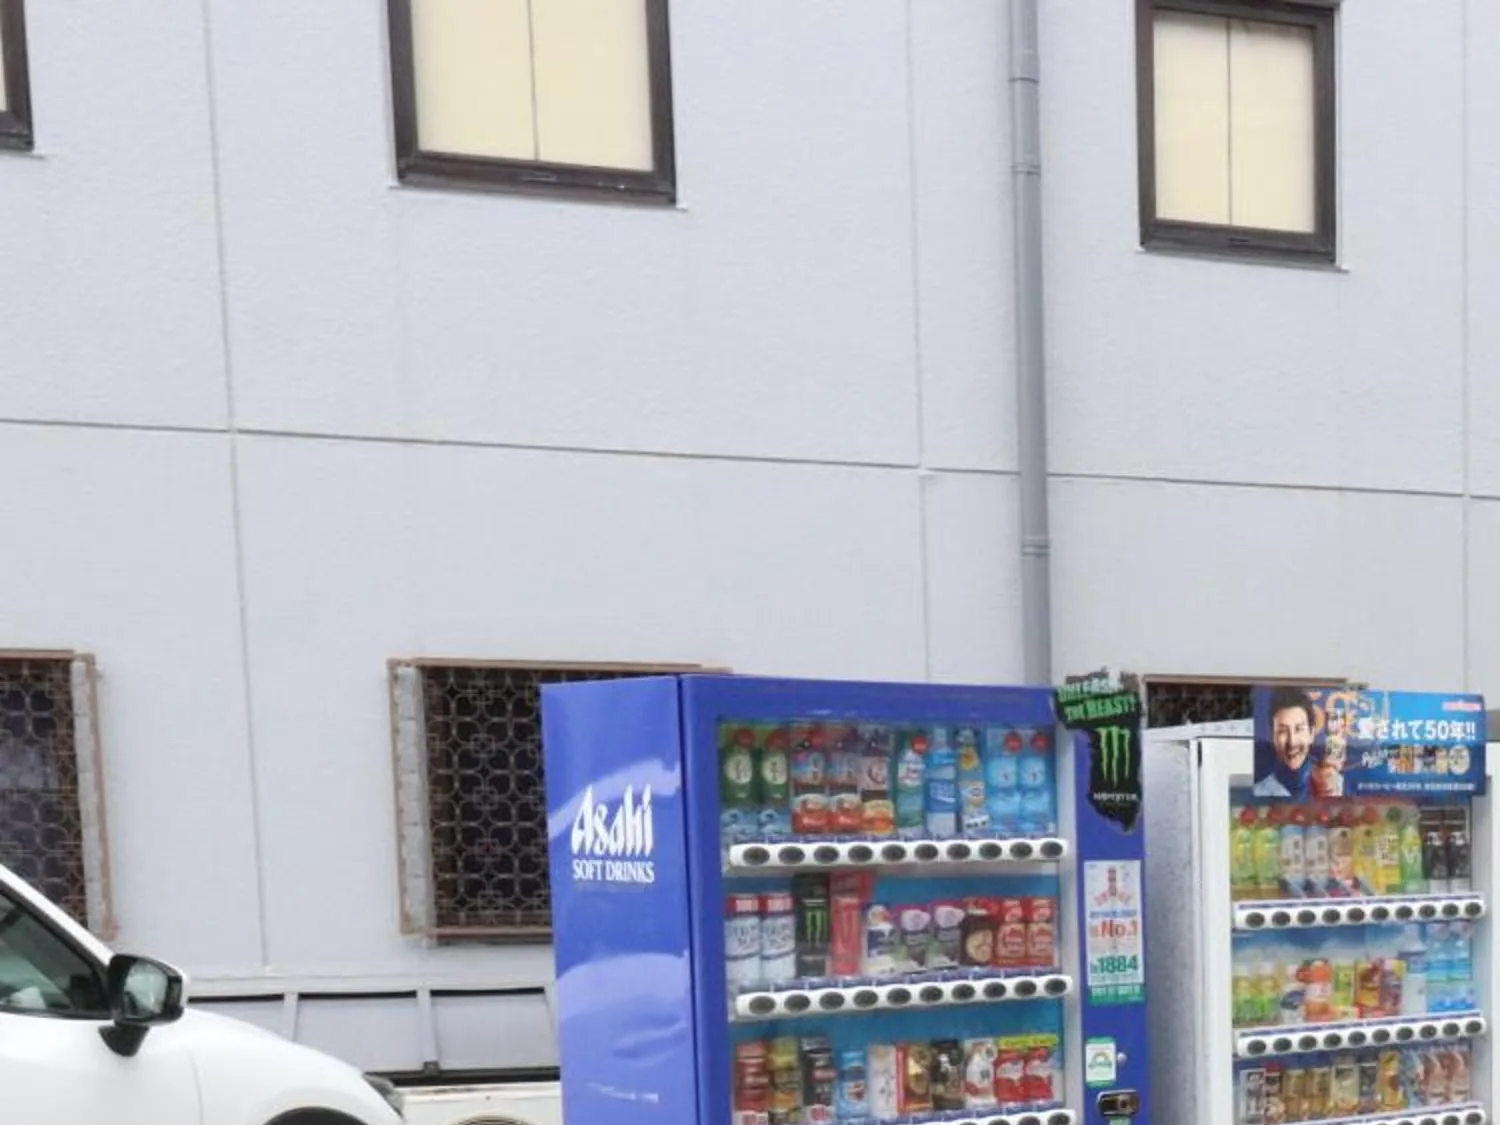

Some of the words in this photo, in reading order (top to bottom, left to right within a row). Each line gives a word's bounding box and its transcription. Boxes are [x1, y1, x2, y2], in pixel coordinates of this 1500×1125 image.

[571, 784, 653, 857] Asahi
[572, 859, 602, 881] SOFT
[605, 860, 655, 883] DRINKS
